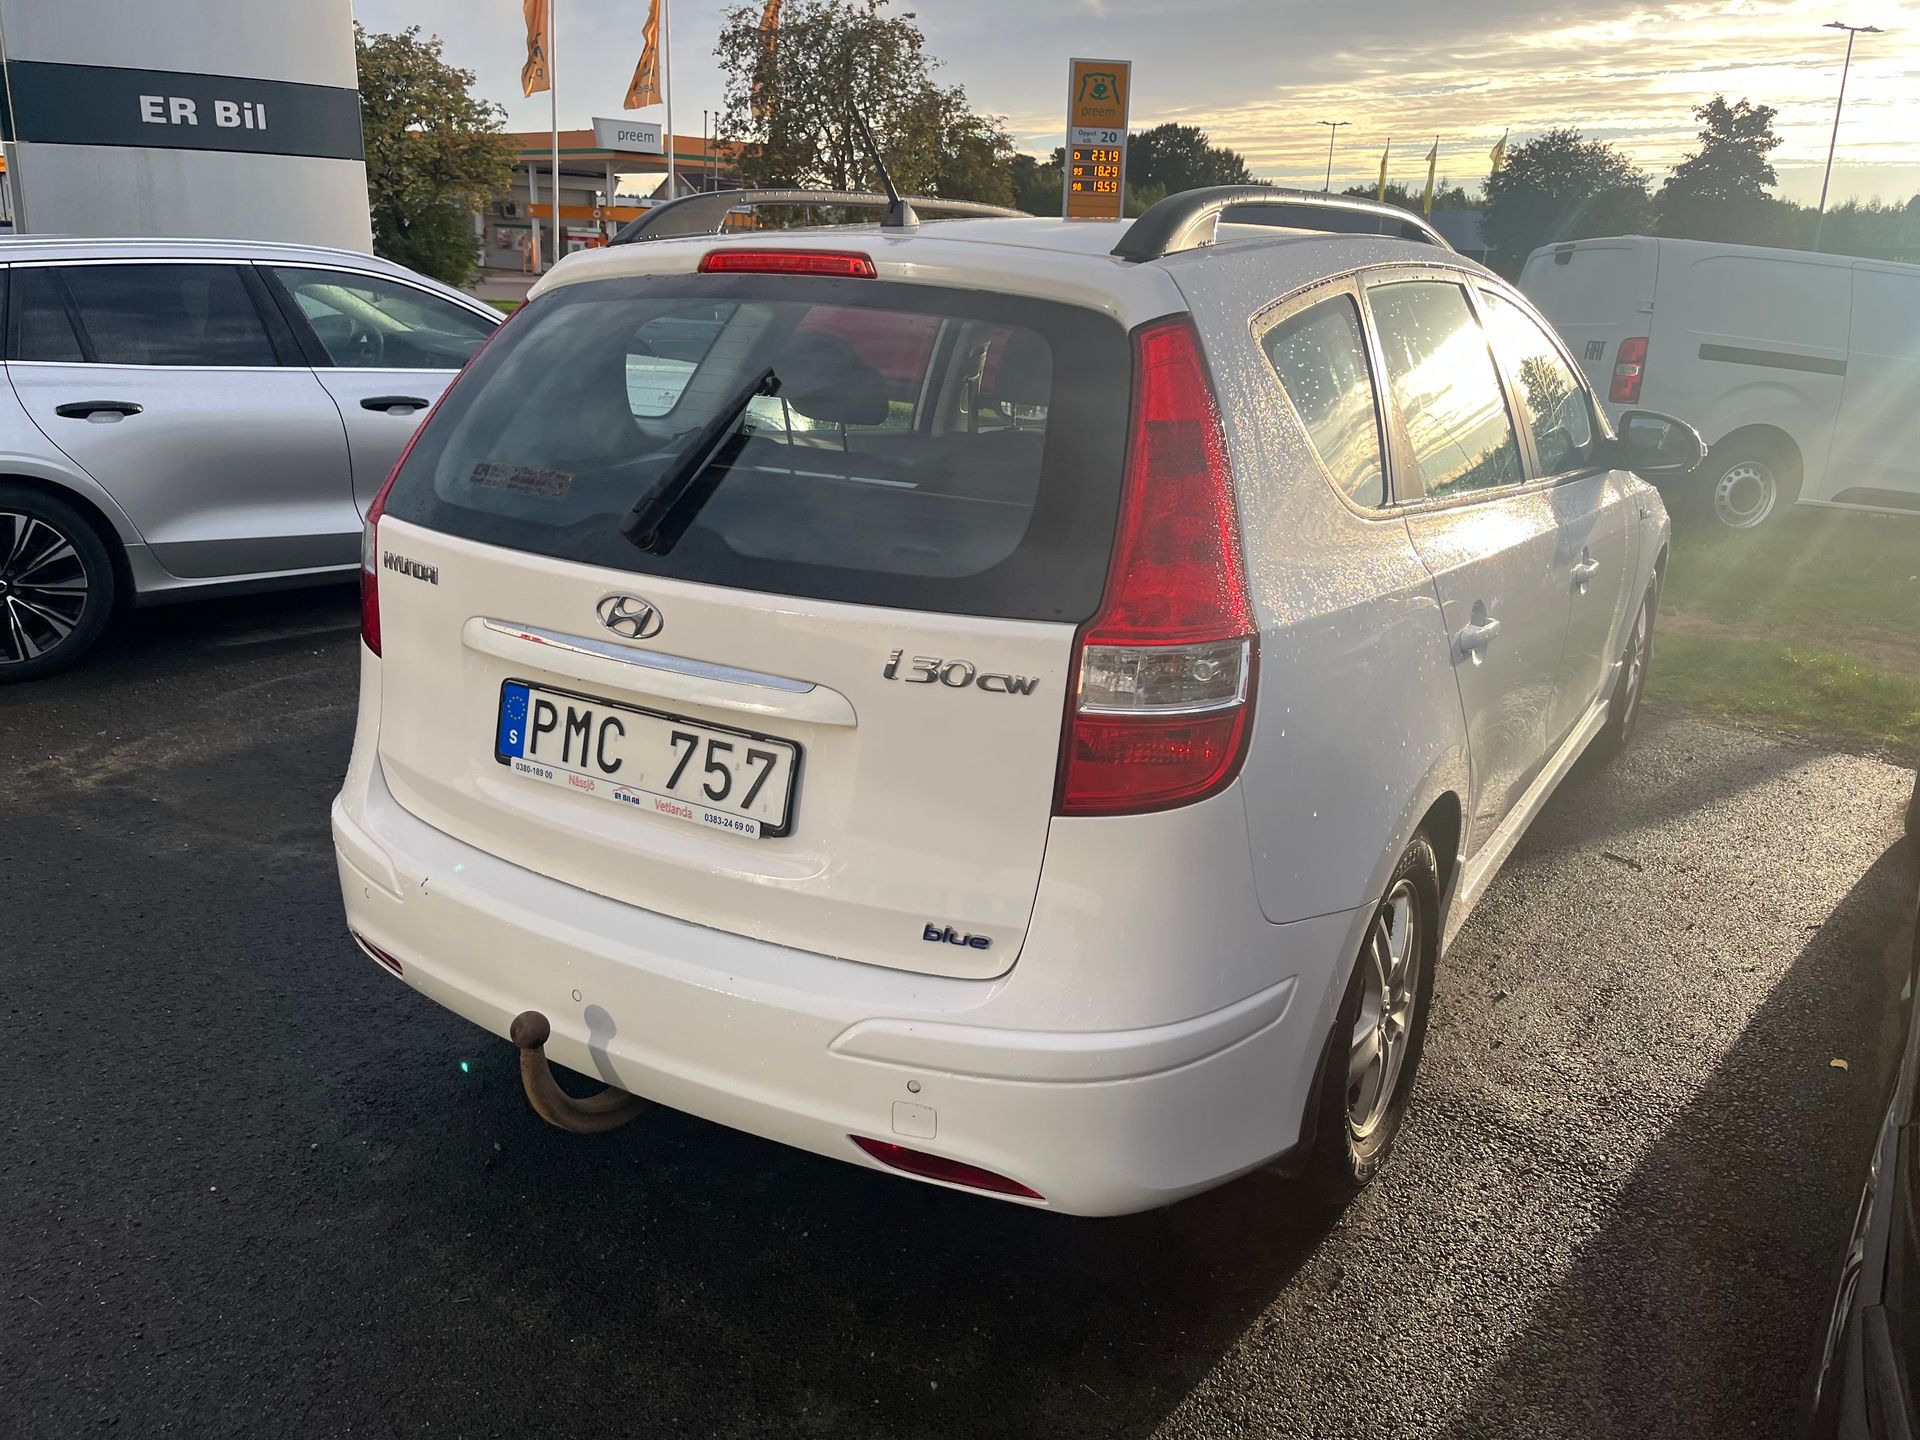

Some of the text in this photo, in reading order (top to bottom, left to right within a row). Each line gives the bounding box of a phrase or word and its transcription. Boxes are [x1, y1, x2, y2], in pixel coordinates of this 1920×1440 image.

[139, 95, 267, 130] ER Bil
[1081, 107, 1116, 119] preem
[617, 130, 655, 143] preem
[1101, 131, 1117, 143] 20
[1073, 149, 1119, 162] D 23.19
[1073, 165, 1119, 178] 95 18.29
[1072, 181, 1118, 193] 98 19.59
[1584, 340, 1608, 361] FIAT
[383, 550, 439, 585] HYUNDAI
[509, 729, 518, 745] S
[529, 698, 778, 809] PMC 757
[515, 762, 553, 780] 0380-189 00
[568, 774, 596, 792] Nässjö
[655, 798, 693, 820] Vetlanda
[704, 813, 755, 834] 0383-24 69 00
[923, 921, 993, 950] blue
